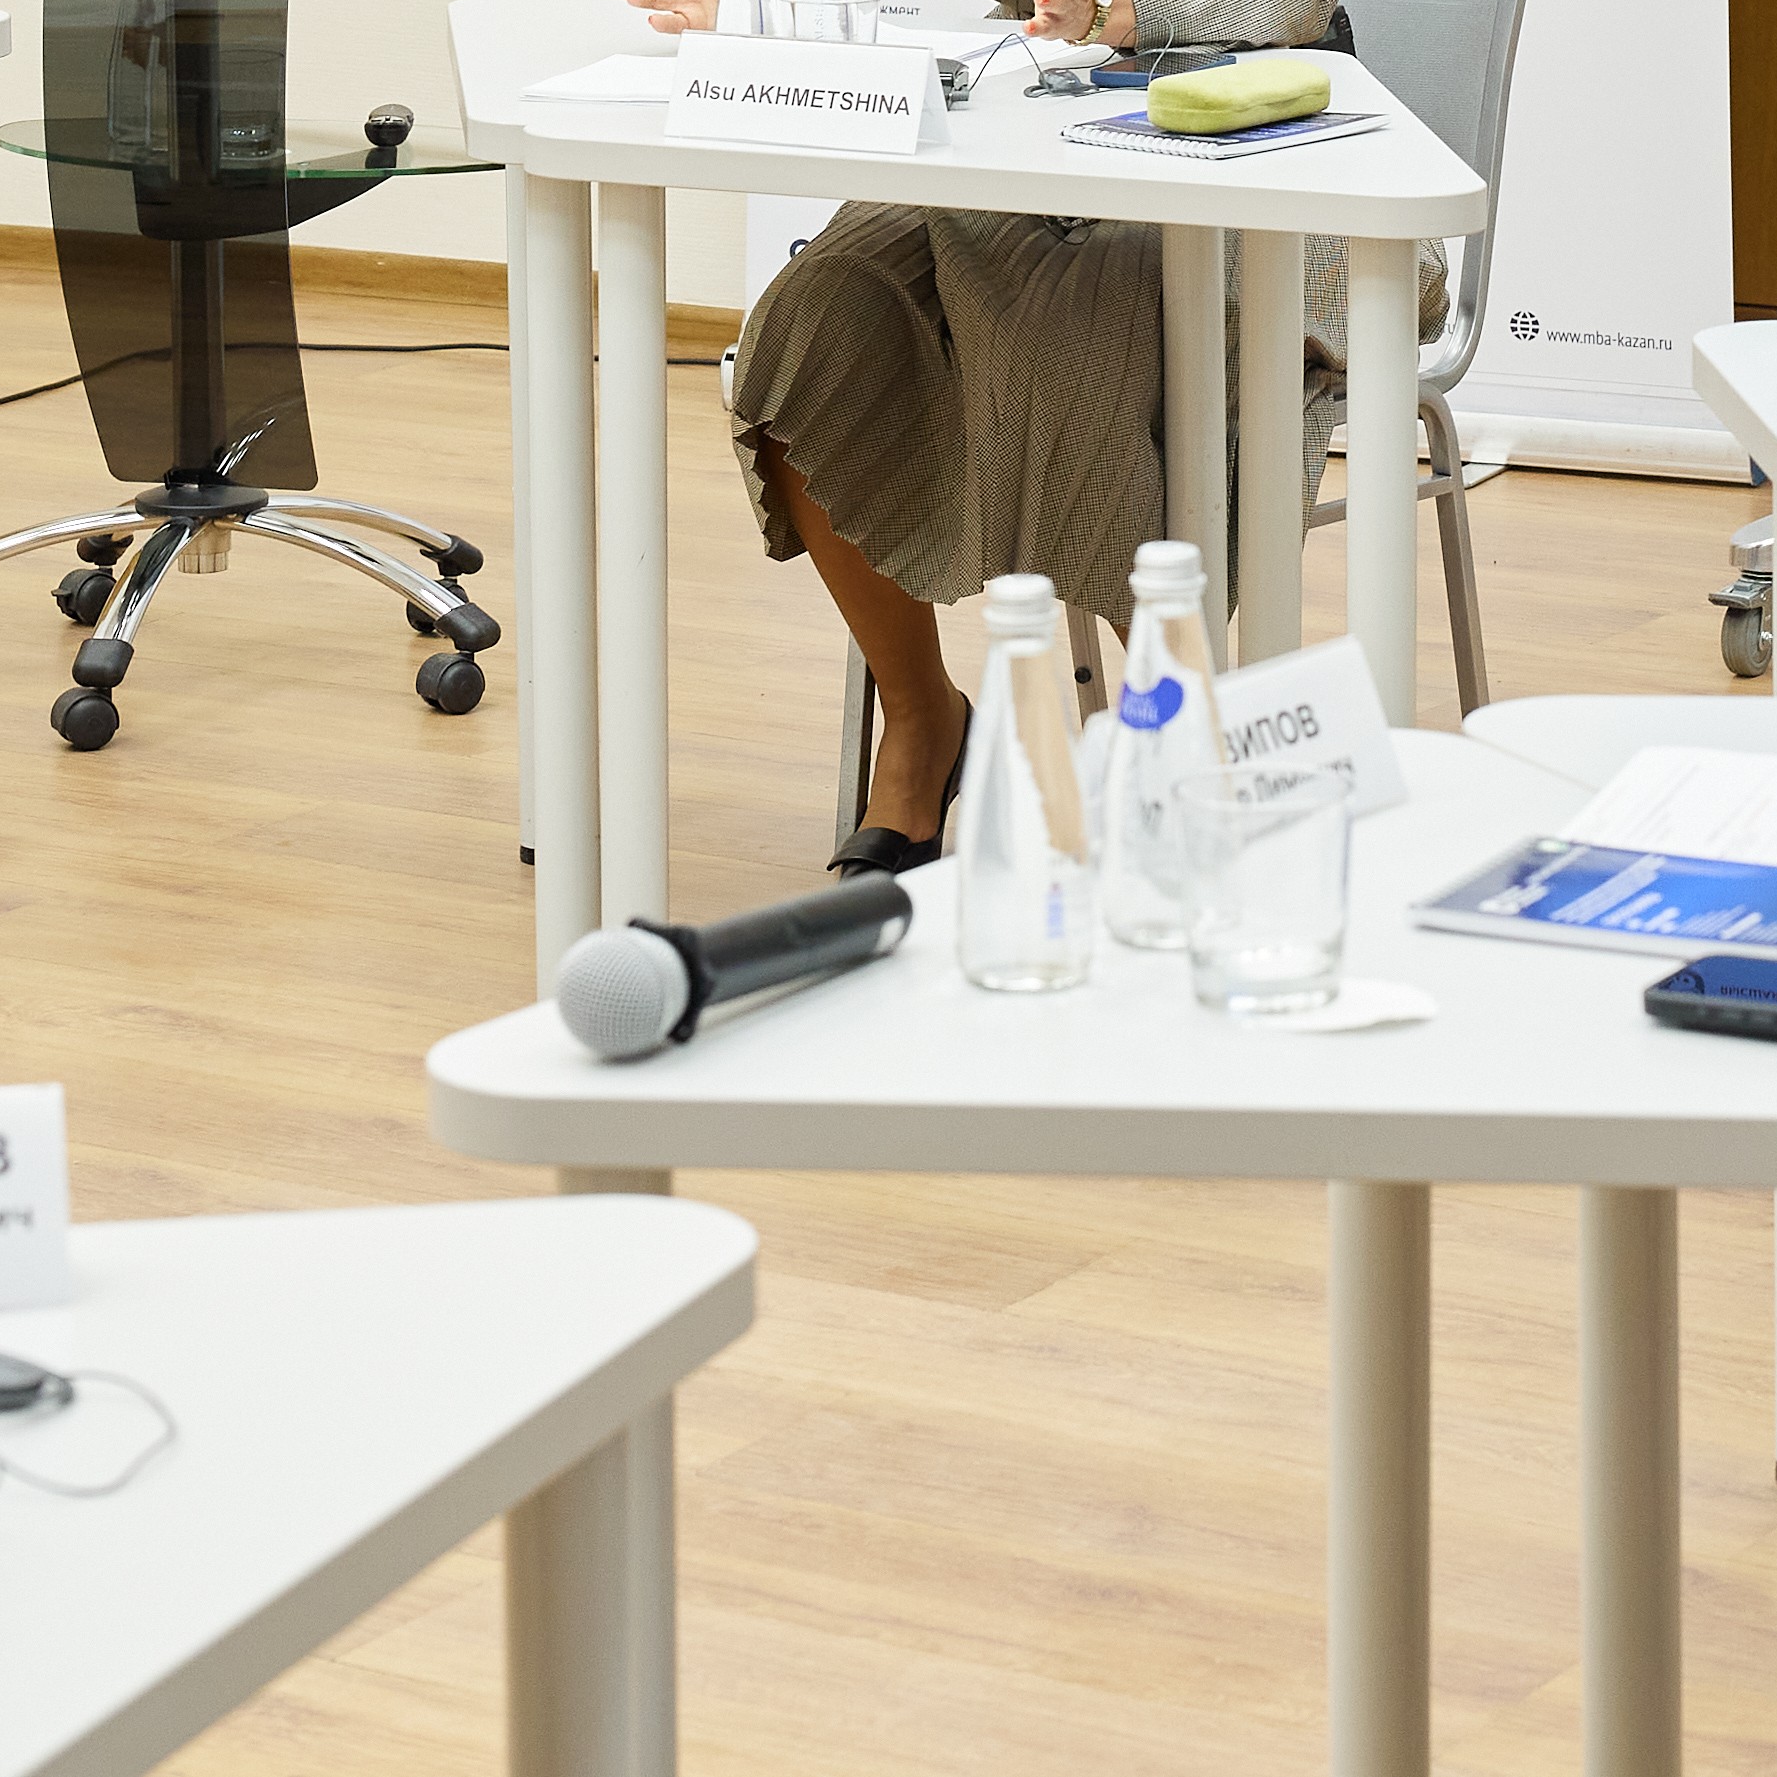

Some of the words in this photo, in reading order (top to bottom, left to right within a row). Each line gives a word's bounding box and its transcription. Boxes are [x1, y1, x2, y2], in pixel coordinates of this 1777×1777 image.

[687, 79, 735, 100] Alsu
[741, 84, 910, 115] AKHMETSHINA
[1546, 330, 1672, 351] www.mba-kazan.ru
